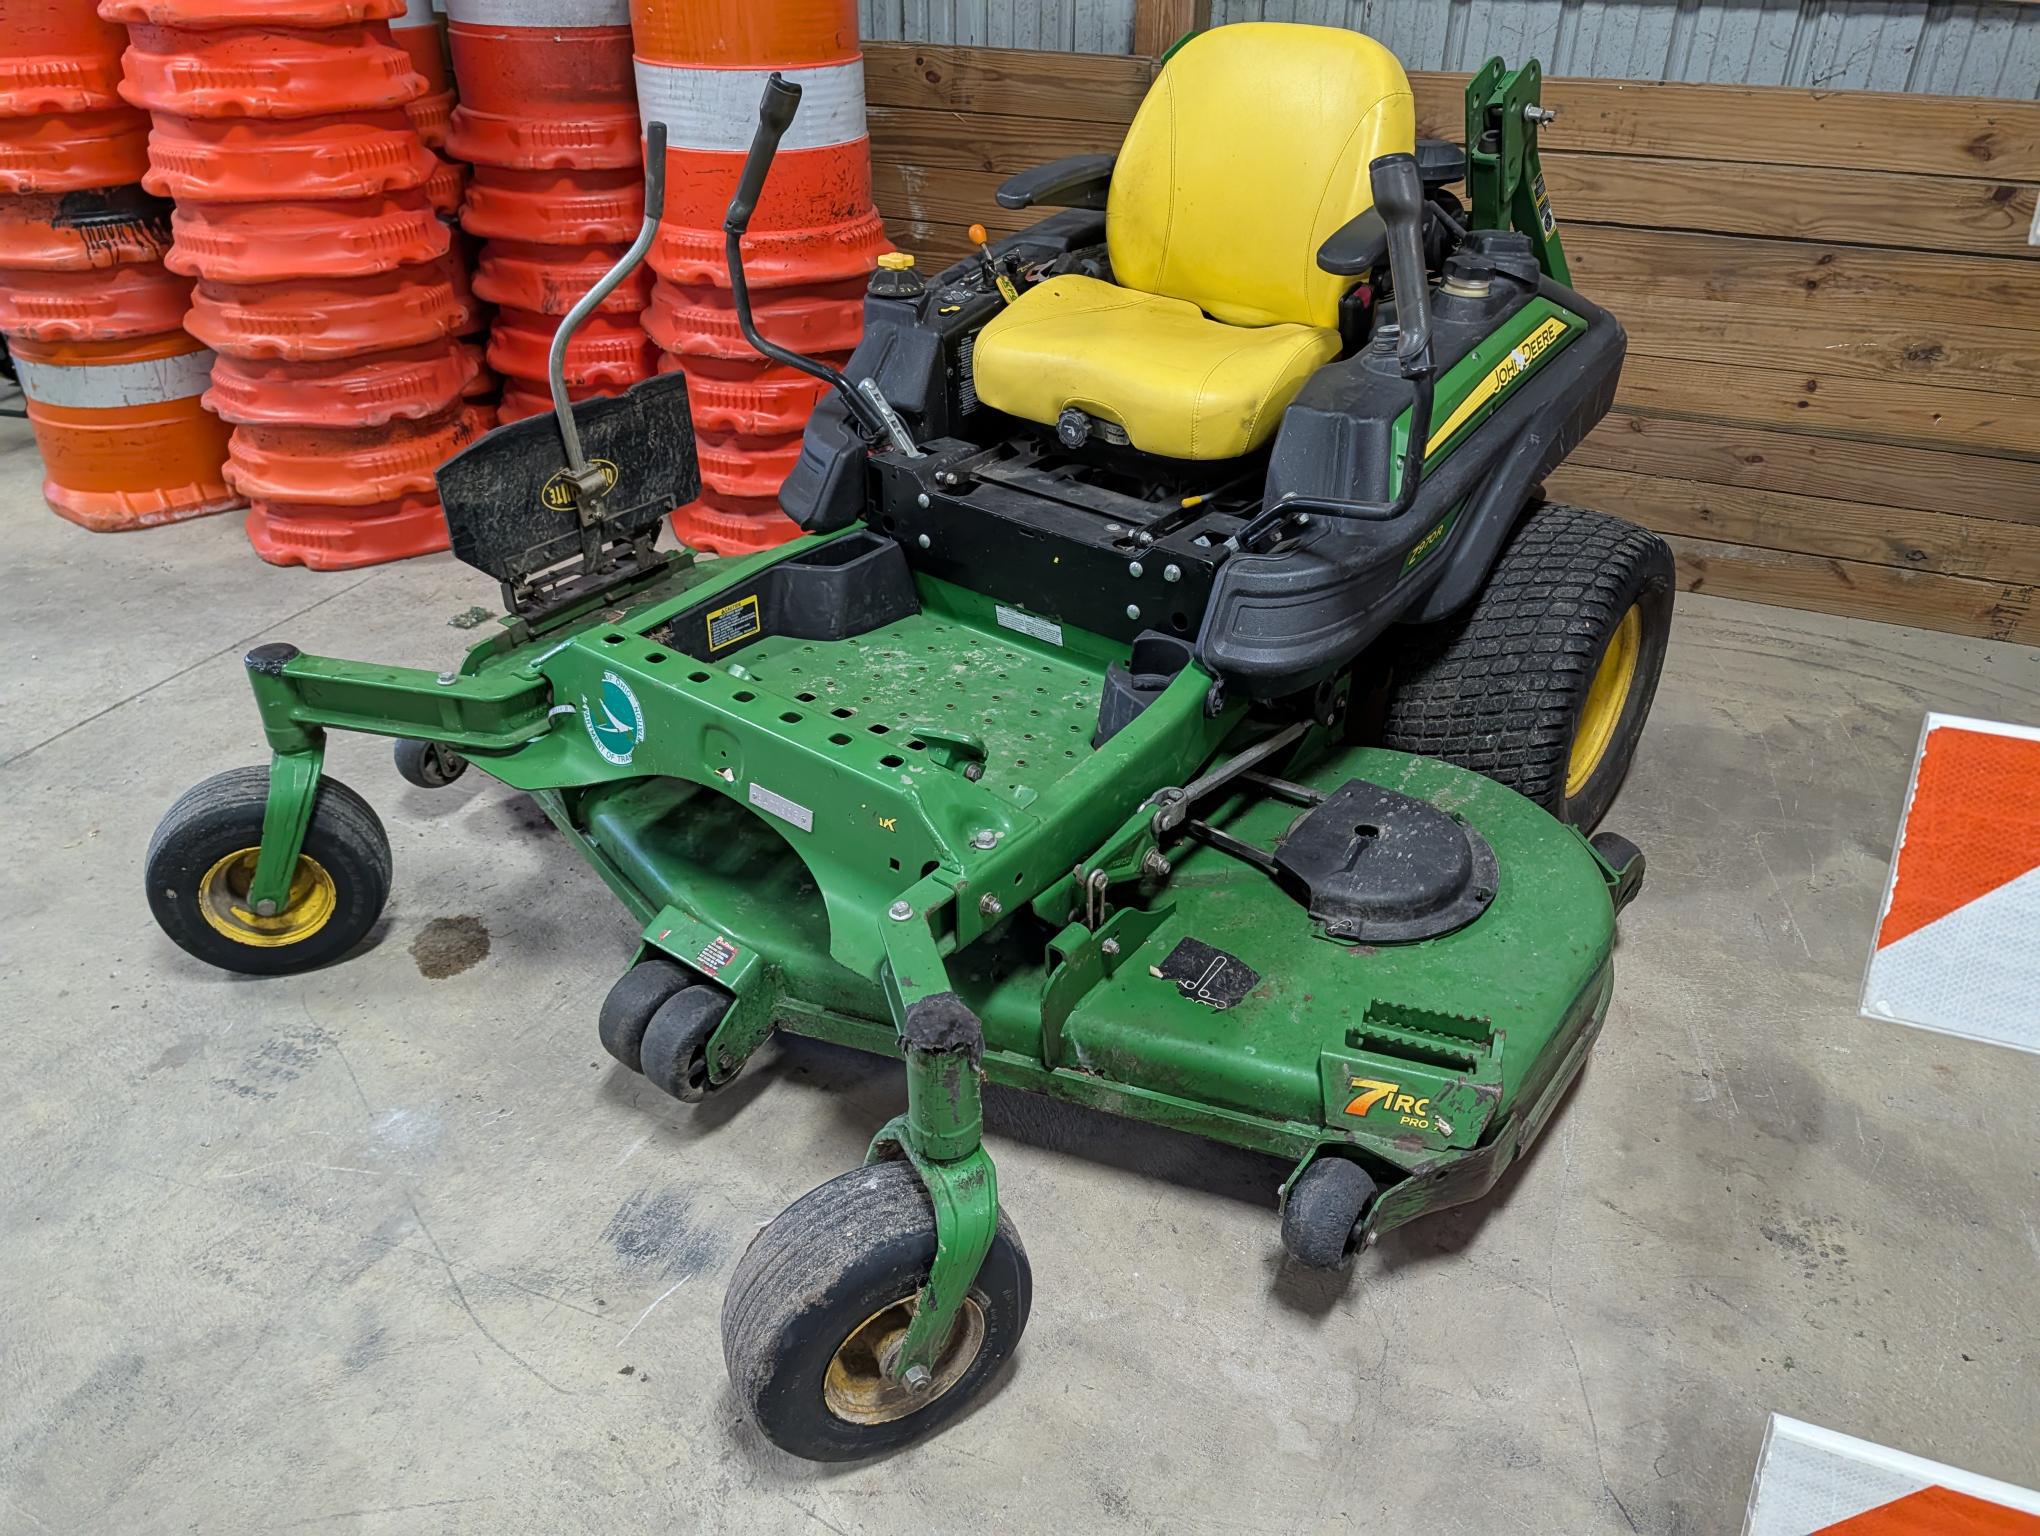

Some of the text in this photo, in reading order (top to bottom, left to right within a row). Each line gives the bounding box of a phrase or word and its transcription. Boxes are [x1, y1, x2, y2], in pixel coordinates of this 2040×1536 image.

[1522, 324, 1557, 364] DEERE
[615, 678, 631, 697] OHIO
[605, 751, 614, 761] OF
[1400, 1116, 1429, 1129] PRO
